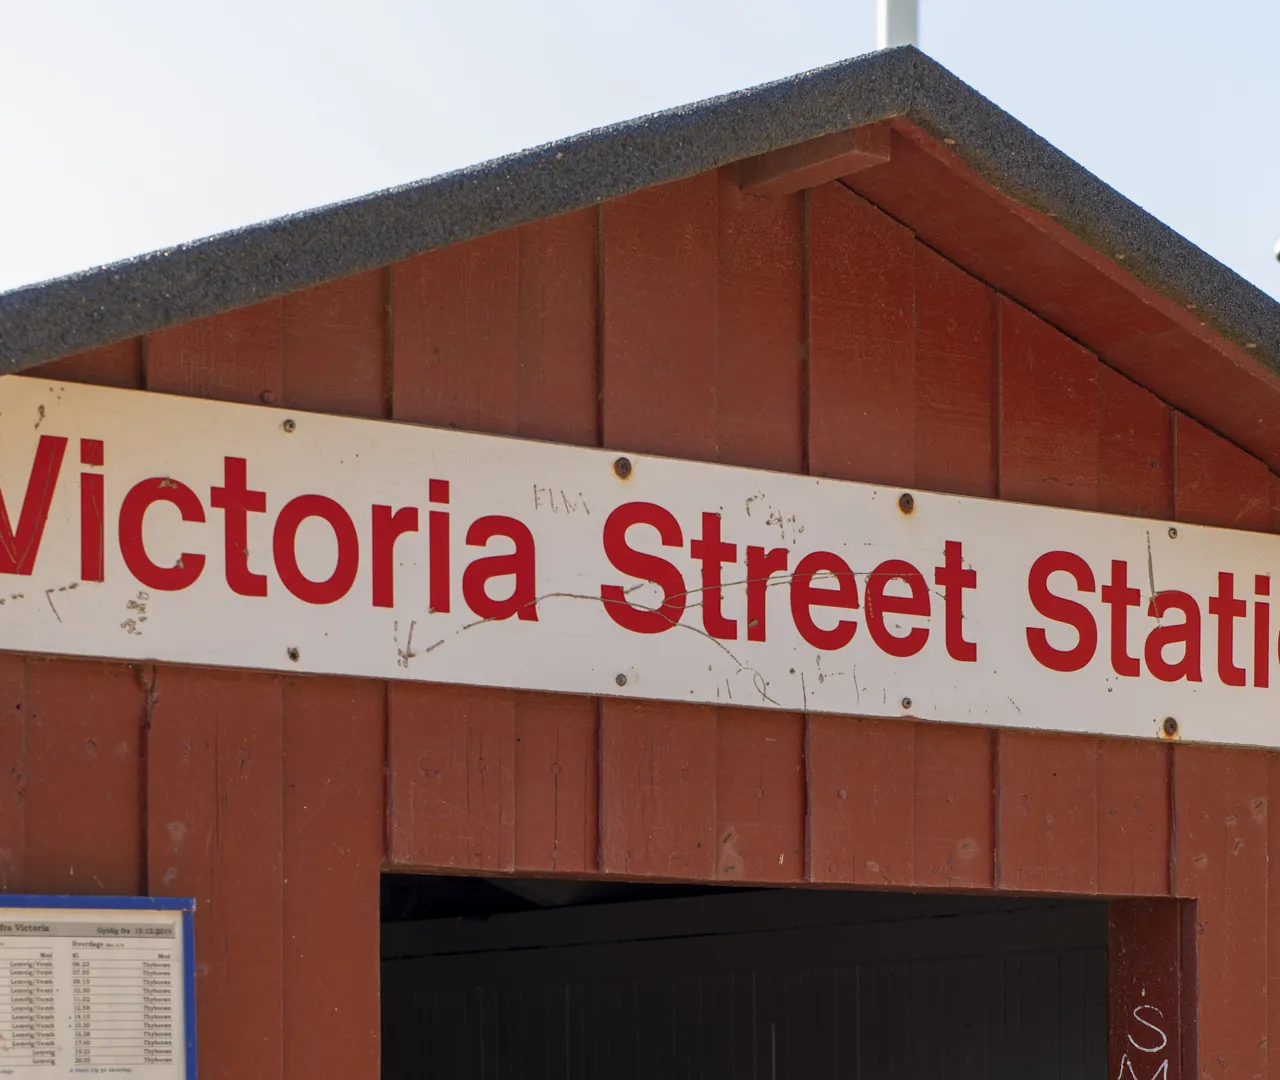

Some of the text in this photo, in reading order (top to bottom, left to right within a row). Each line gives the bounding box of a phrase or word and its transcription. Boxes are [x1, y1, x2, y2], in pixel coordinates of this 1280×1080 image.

[601, 502, 976, 662] Street
[0, 923, 12, 932] fra
[14, 924, 50, 932] Victoria
[97, 927, 119, 935] Gyldig
